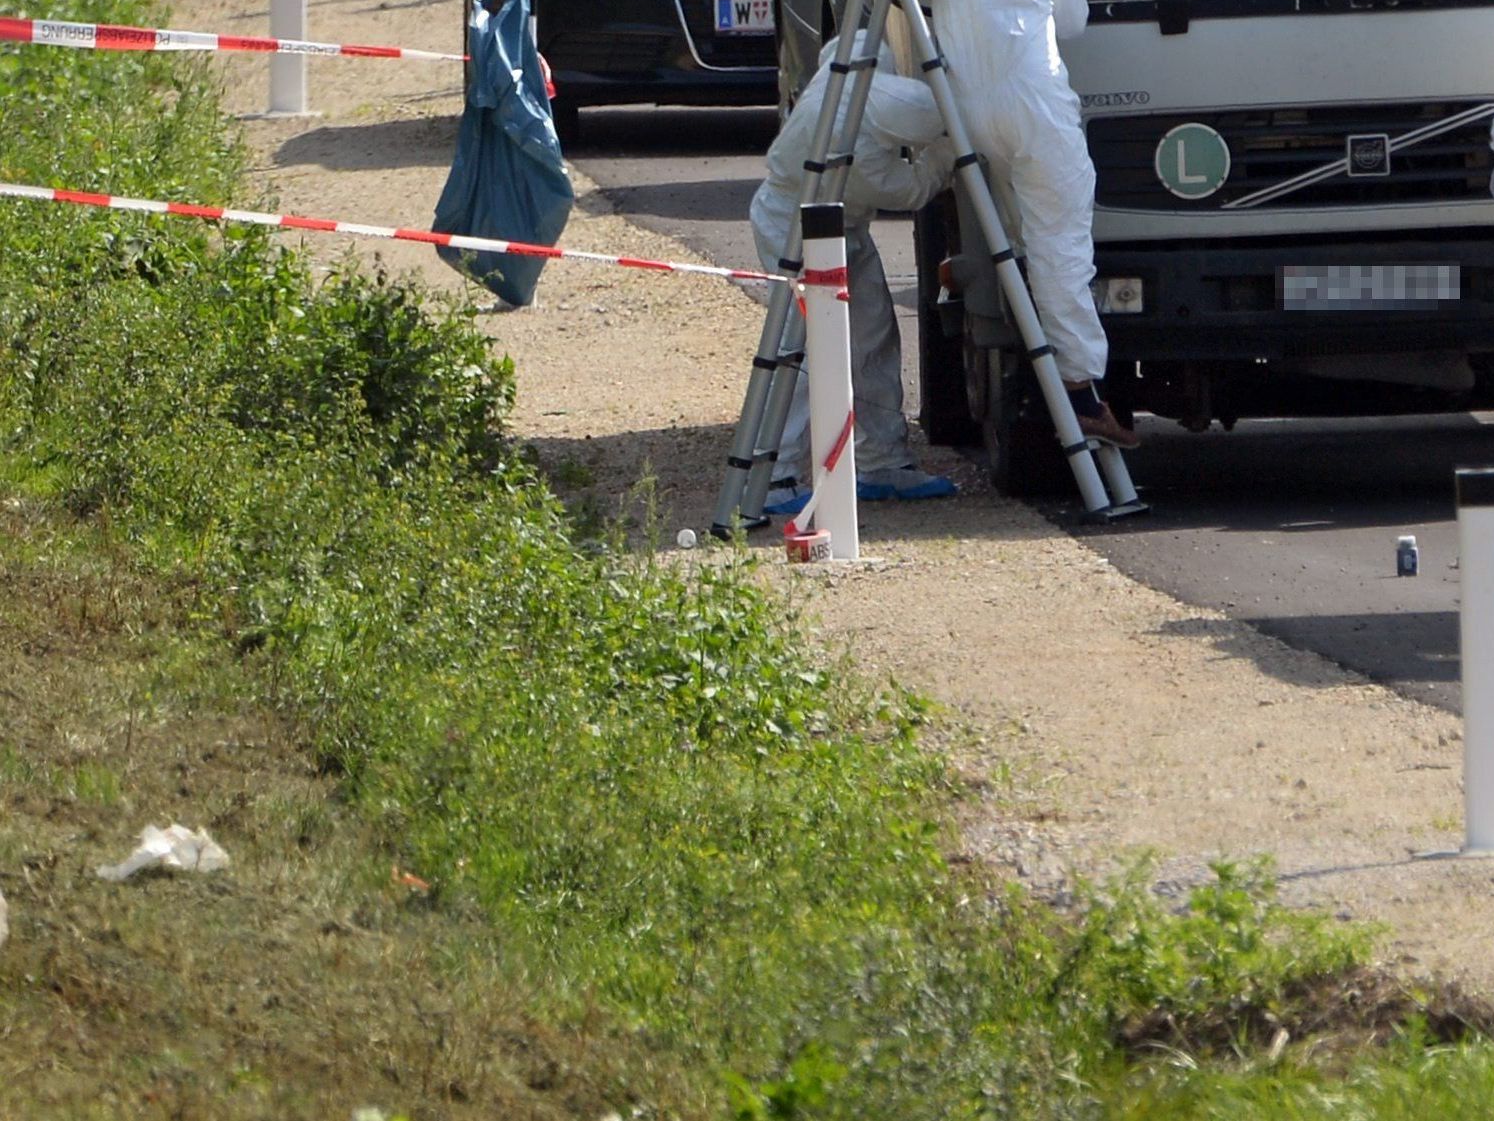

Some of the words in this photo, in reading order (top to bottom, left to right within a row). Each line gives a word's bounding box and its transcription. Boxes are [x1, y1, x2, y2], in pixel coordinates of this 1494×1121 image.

[735, 2, 752, 25] W
[1080, 90, 1150, 108] VOLVO
[1177, 139, 1207, 184] L
